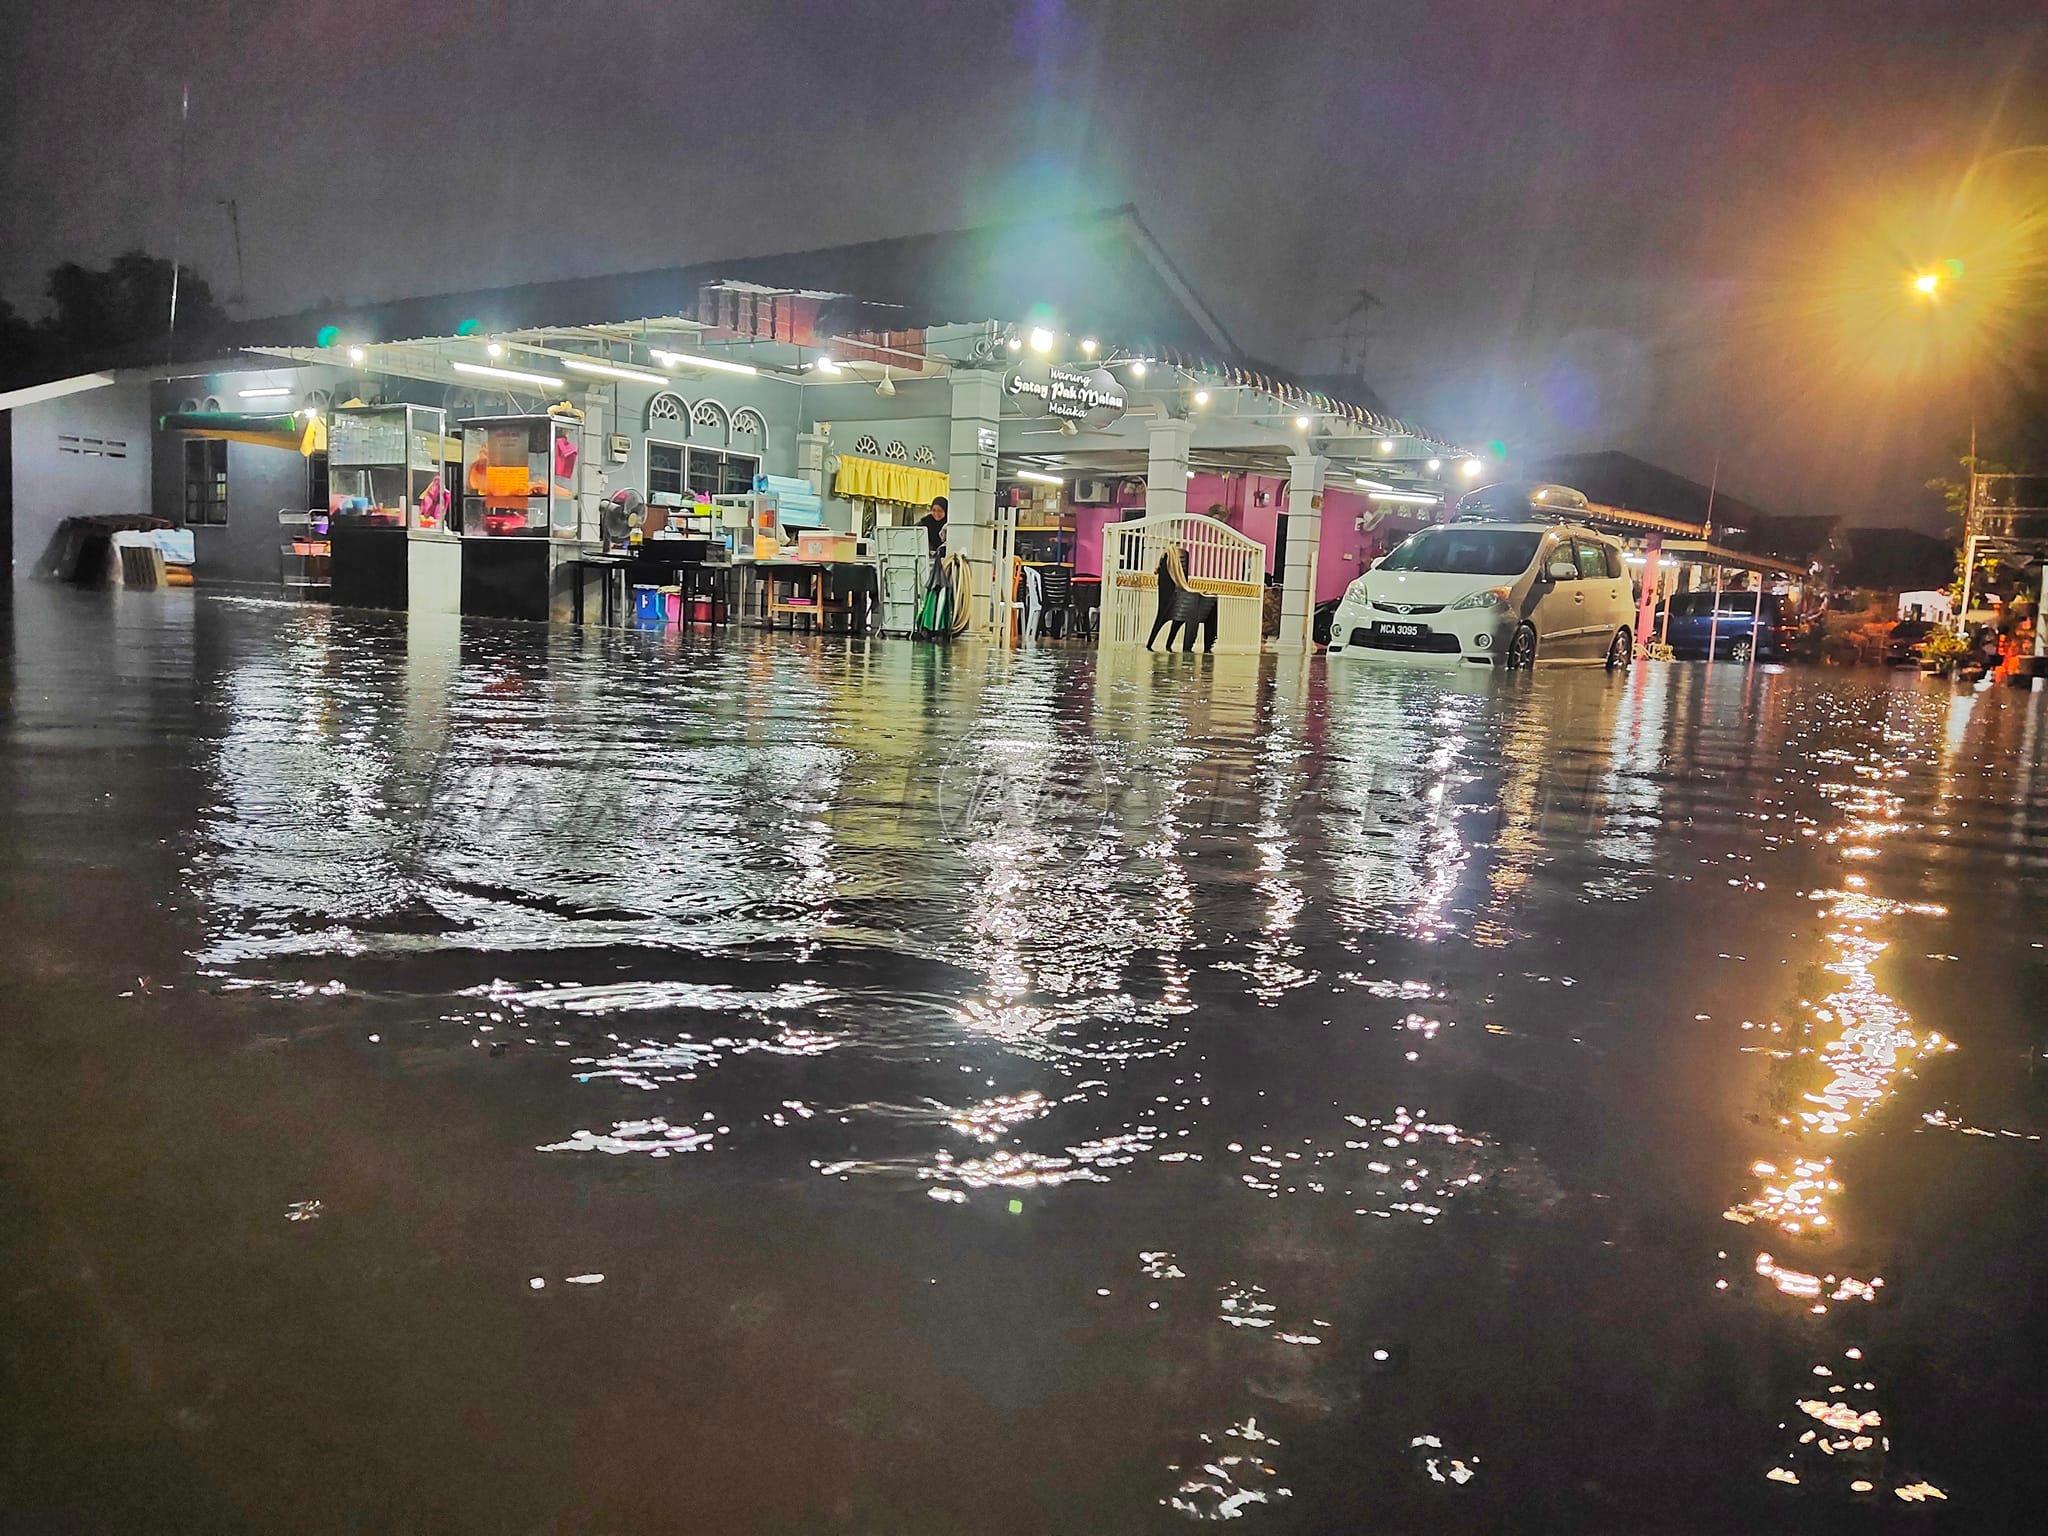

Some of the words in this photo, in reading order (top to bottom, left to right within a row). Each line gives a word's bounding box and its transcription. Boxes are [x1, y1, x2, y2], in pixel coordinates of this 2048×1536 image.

[1050, 367, 1092, 387] Warung
[1010, 376, 1049, 399] Satay
[1050, 382, 1077, 400] Pak
[1049, 402, 1088, 418] Melaka
[1397, 625, 1418, 635] 3095
